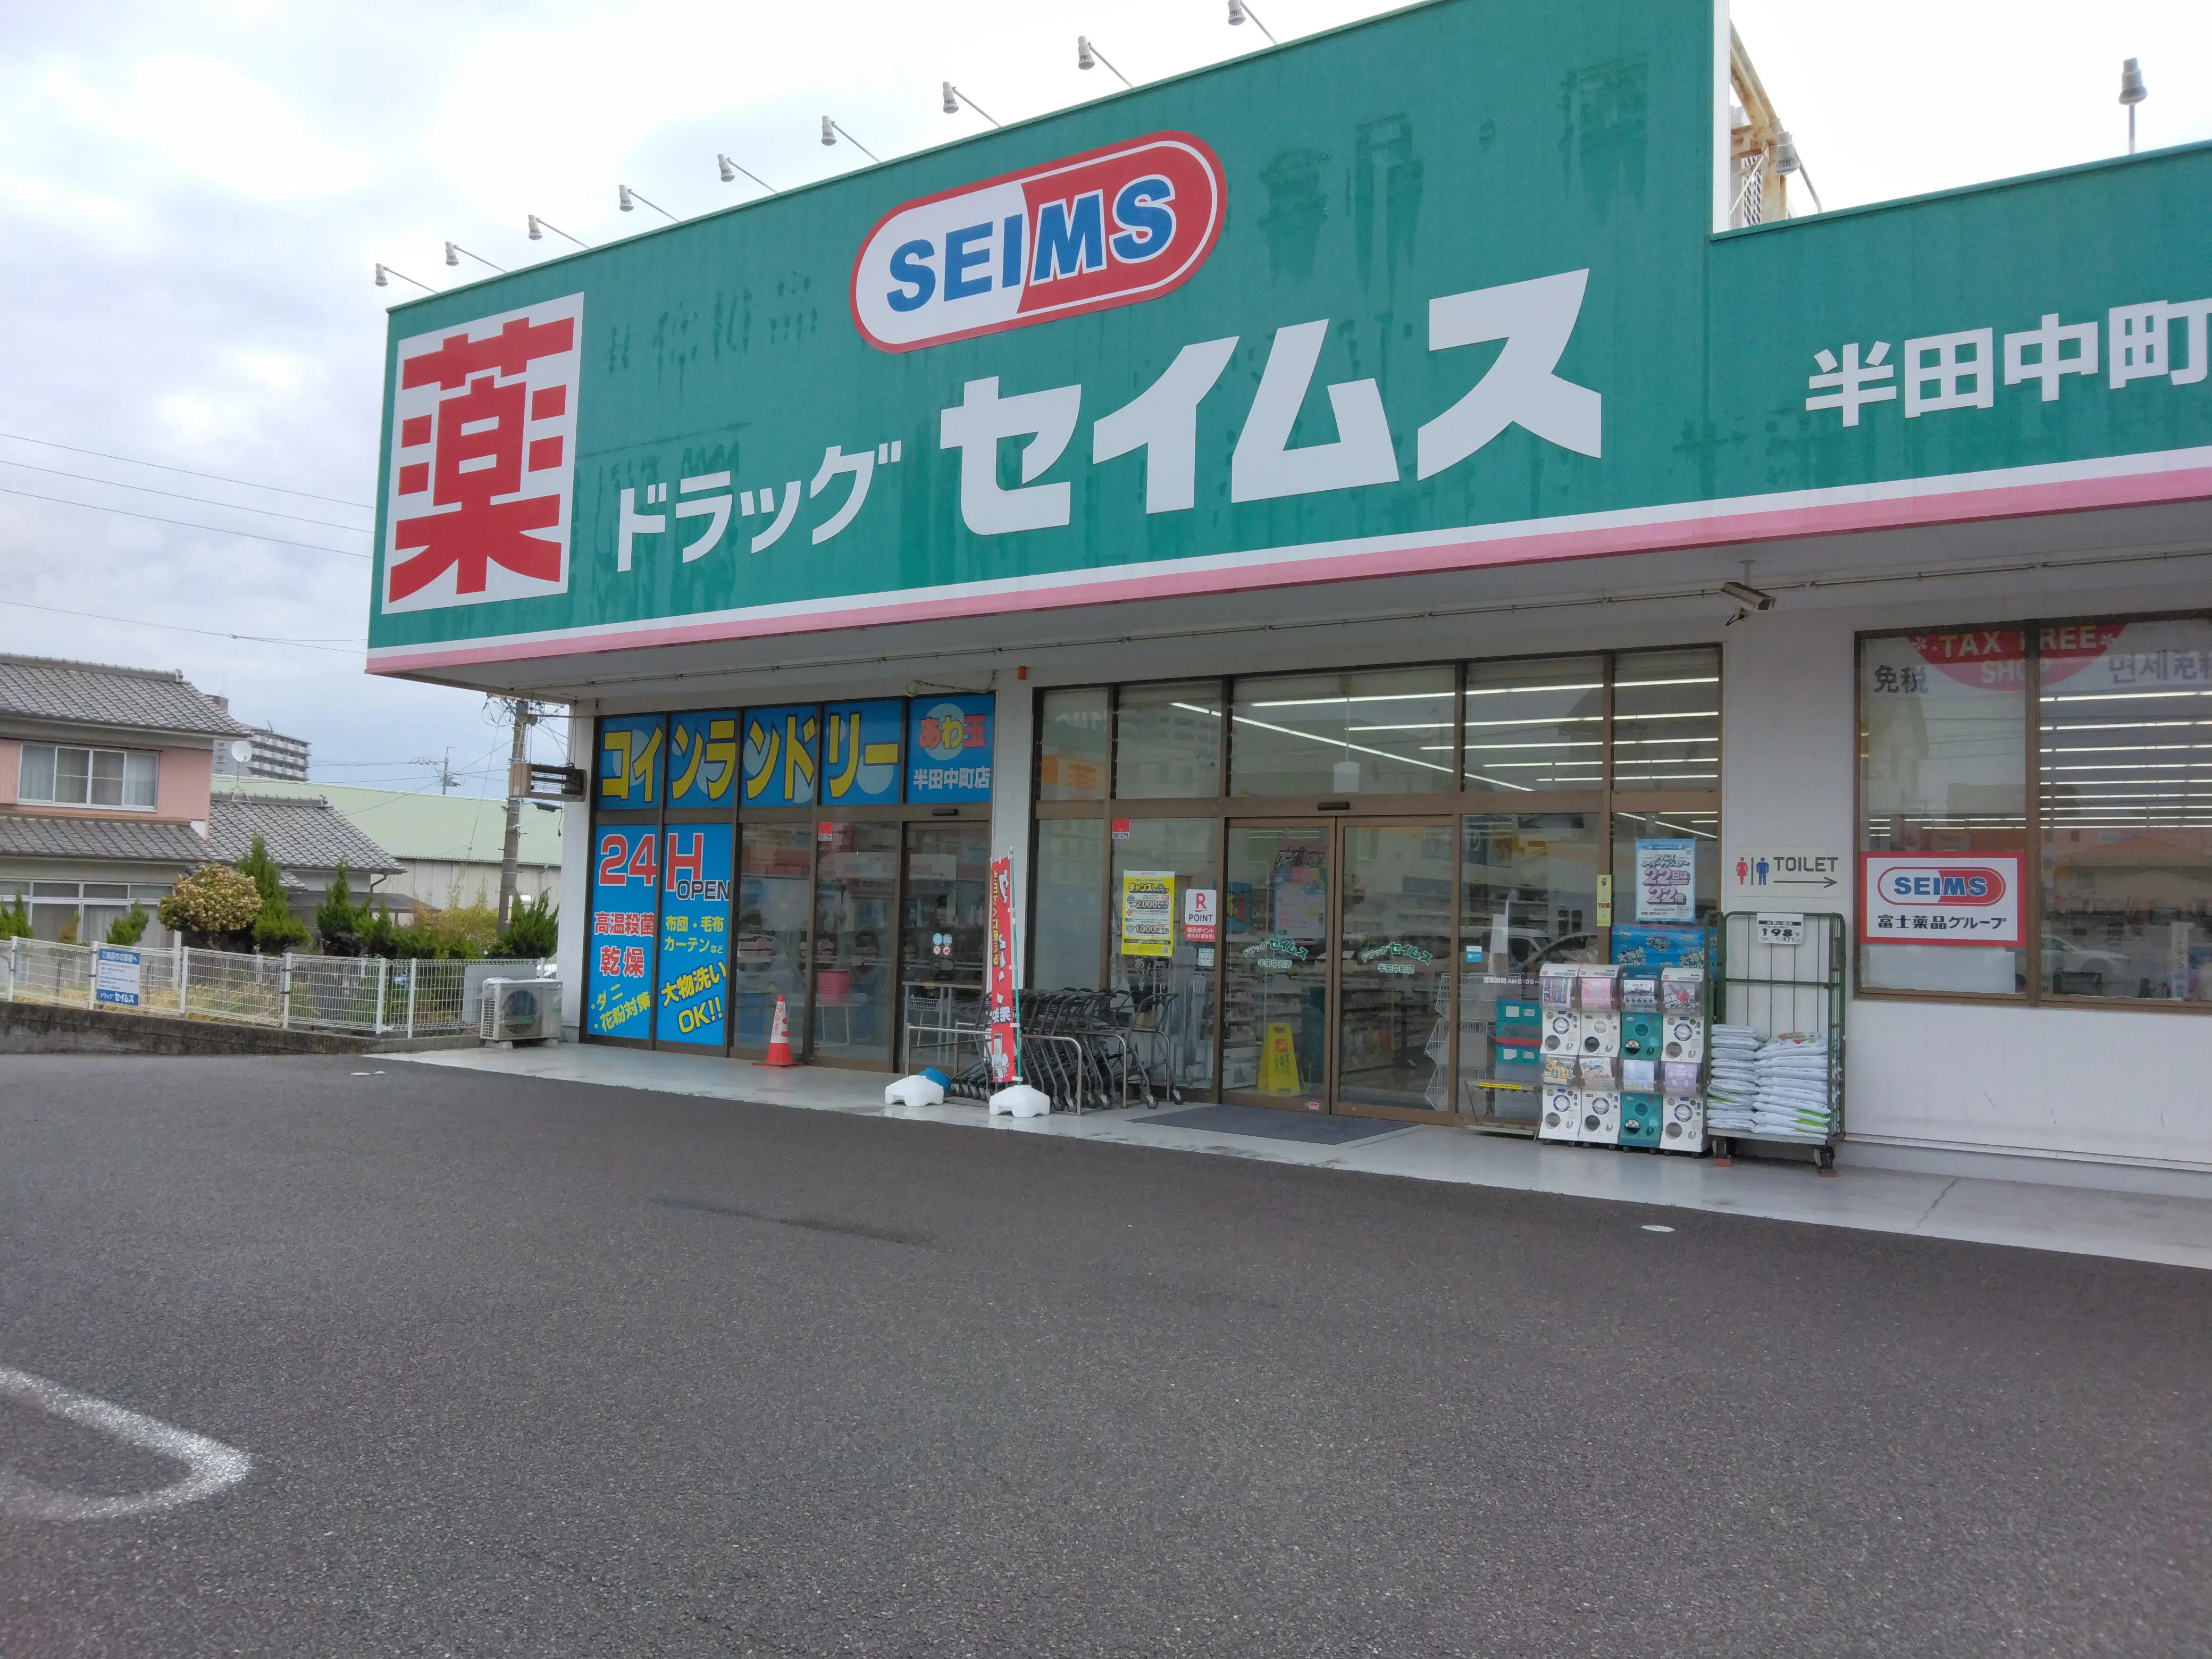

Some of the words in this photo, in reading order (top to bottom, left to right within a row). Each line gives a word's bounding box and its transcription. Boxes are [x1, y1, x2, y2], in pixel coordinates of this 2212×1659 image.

[885, 173, 1177, 313] SEIMS
[1806, 298, 2212, 427] 半田中町
[617, 440, 902, 572] ドラッグ
[940, 267, 1602, 535] セイムス
[389, 316, 574, 604] 薬
[1939, 630, 2002, 658] TAX
[2020, 625, 2097, 652] REE
[1873, 664, 1928, 693] 免税
[919, 715, 986, 750] あわ玉
[601, 714, 900, 803] コインランドリー
[913, 766, 991, 790] 半田中町店
[1773, 856, 1839, 873] TOILET
[676, 879, 731, 902] OPEN
[1893, 876, 1988, 897] SEIMS
[594, 911, 655, 937] 高温殺菌
[665, 915, 725, 933] 布団・毛布
[1188, 914, 1213, 923] POINT
[1878, 914, 2007, 930] 富士薬品グループ
[1762, 928, 1794, 937] 198
[599, 945, 645, 978] 乾燥
[1269, 938, 1309, 961] セイムス
[1389, 942, 1433, 966] セイムス
[1258, 958, 1293, 969] 半田中町店
[1377, 963, 1415, 974] 半田中町店
[661, 961, 727, 1008] 大物洗い
